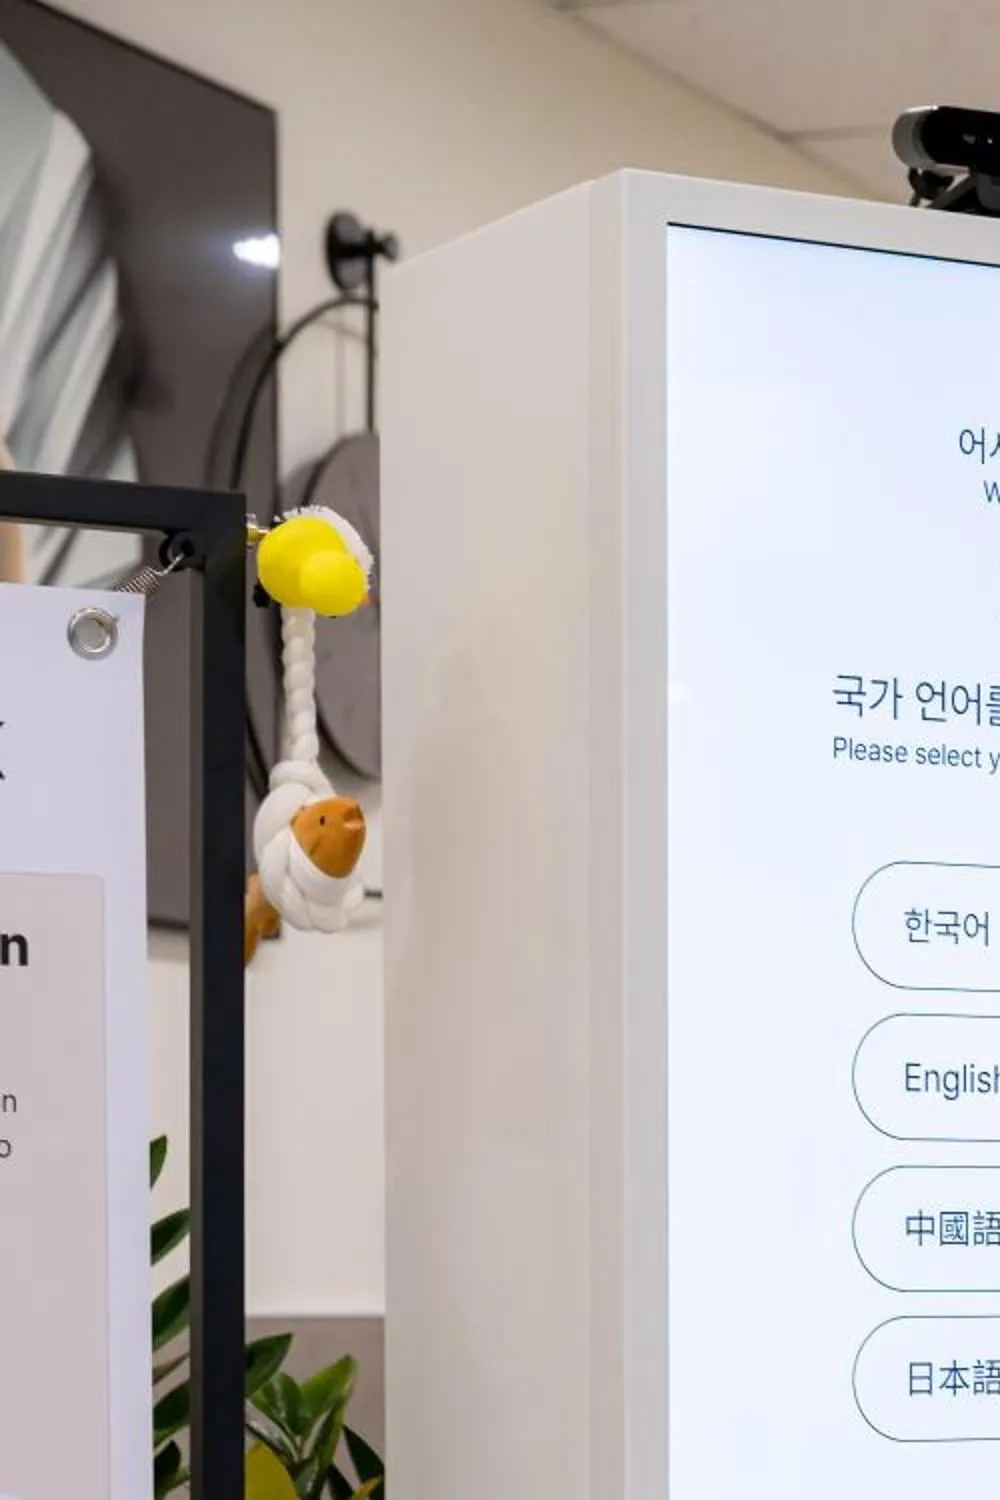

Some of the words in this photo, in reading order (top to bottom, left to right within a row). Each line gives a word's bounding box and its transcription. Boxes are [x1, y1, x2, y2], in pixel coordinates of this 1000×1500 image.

[832, 674, 904, 720] 국가
[832, 736, 908, 763] Please
[914, 742, 981, 769] select
[903, 907, 991, 946] 한국어
